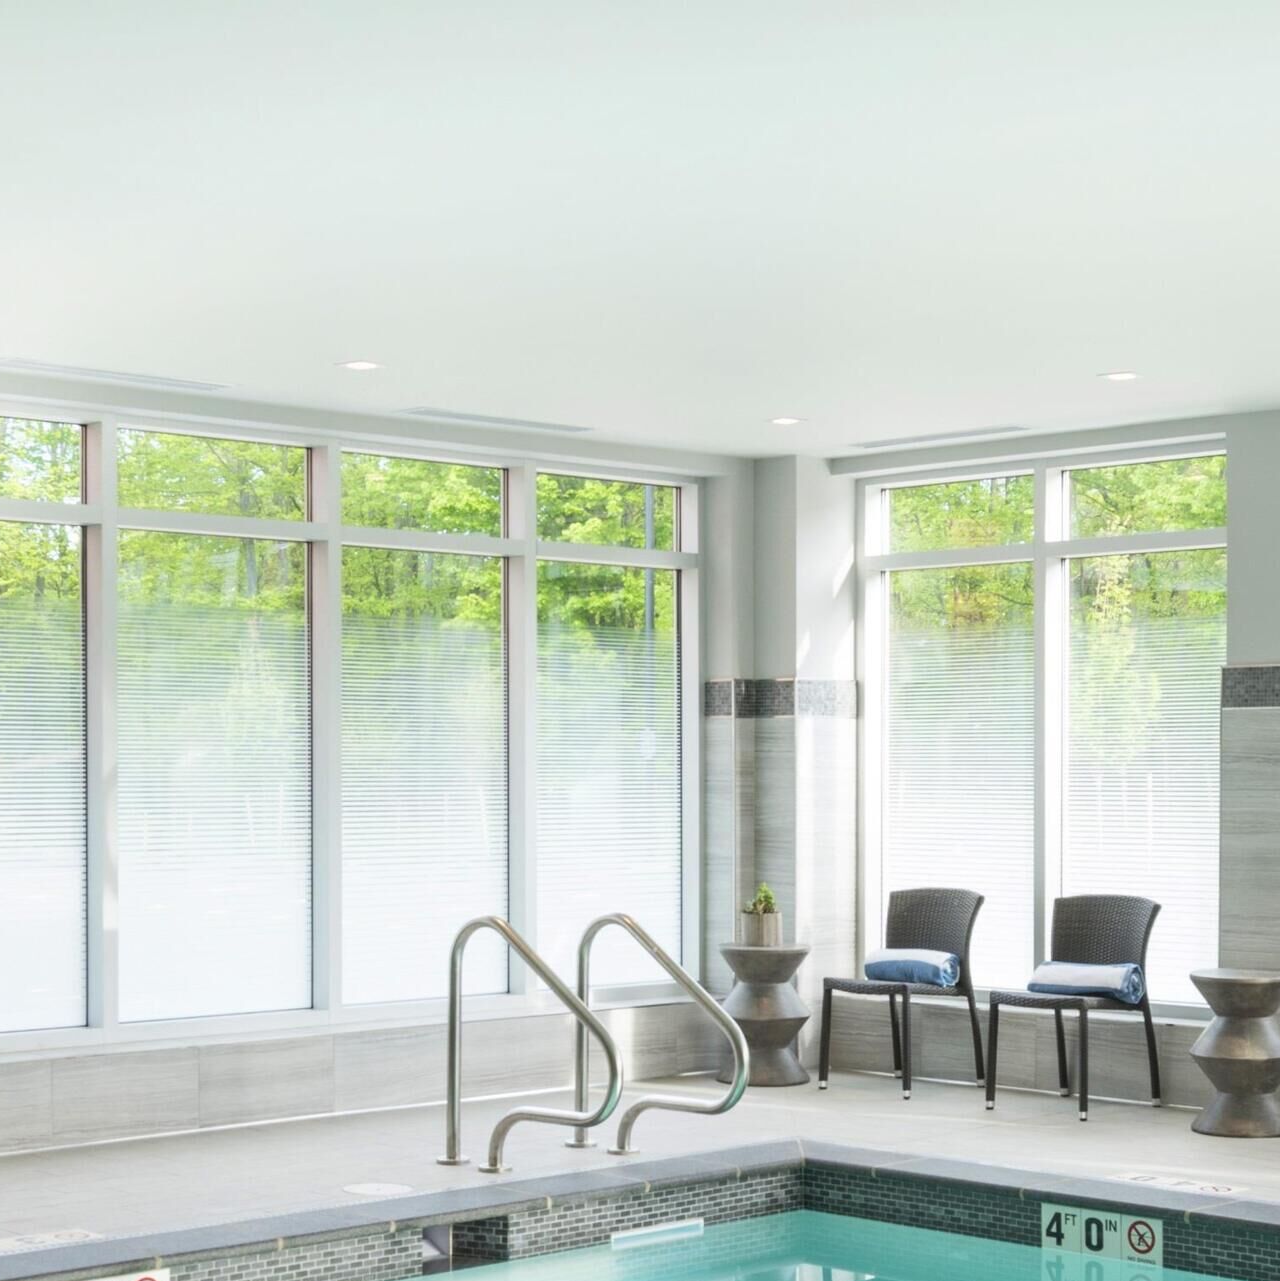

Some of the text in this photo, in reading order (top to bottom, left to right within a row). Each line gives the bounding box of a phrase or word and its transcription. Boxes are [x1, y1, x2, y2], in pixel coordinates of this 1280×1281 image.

[1046, 1212, 1117, 1251] 4 FT 0 IN
